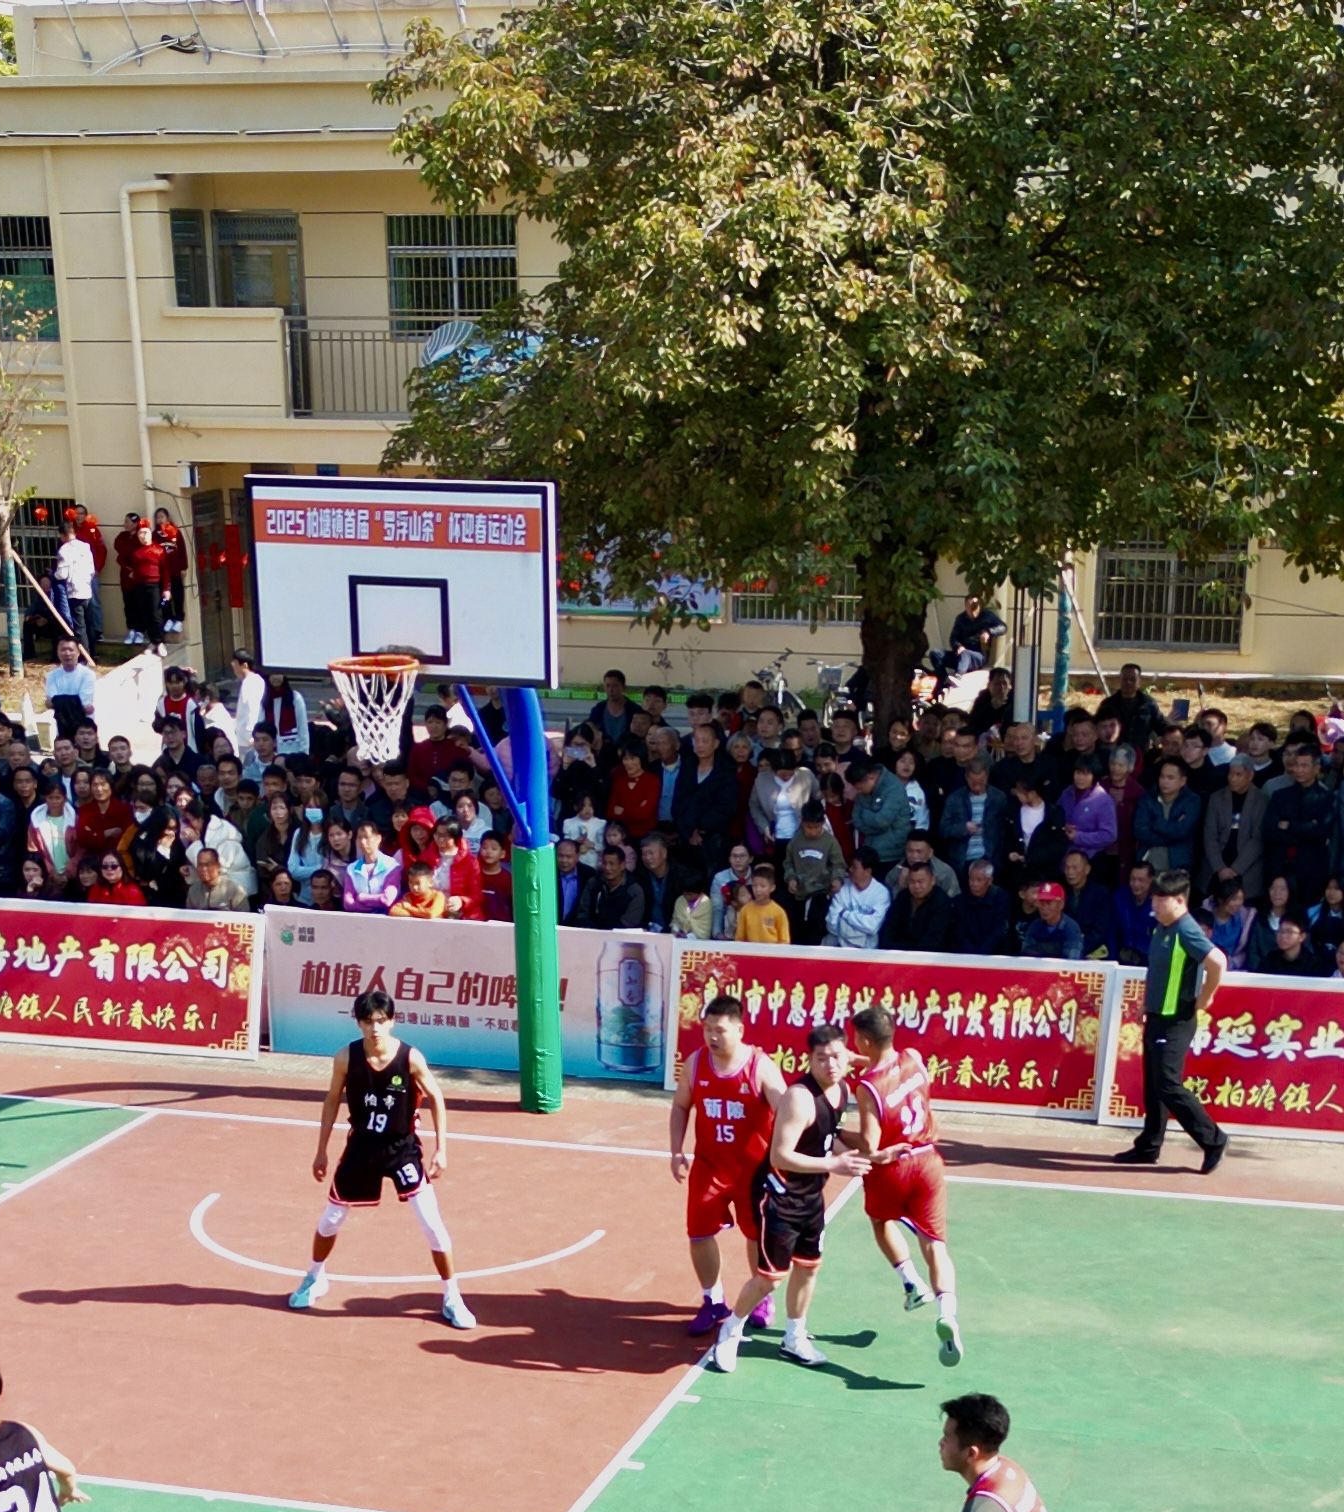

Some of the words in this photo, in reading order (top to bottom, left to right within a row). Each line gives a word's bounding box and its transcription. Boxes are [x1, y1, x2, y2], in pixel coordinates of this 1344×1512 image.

[299, 960, 568, 1012] 柏塘人自己的啤！
[366, 1111, 388, 1133] 19
[715, 1124, 735, 1143] 15
[396, 1162, 420, 1187] 19
